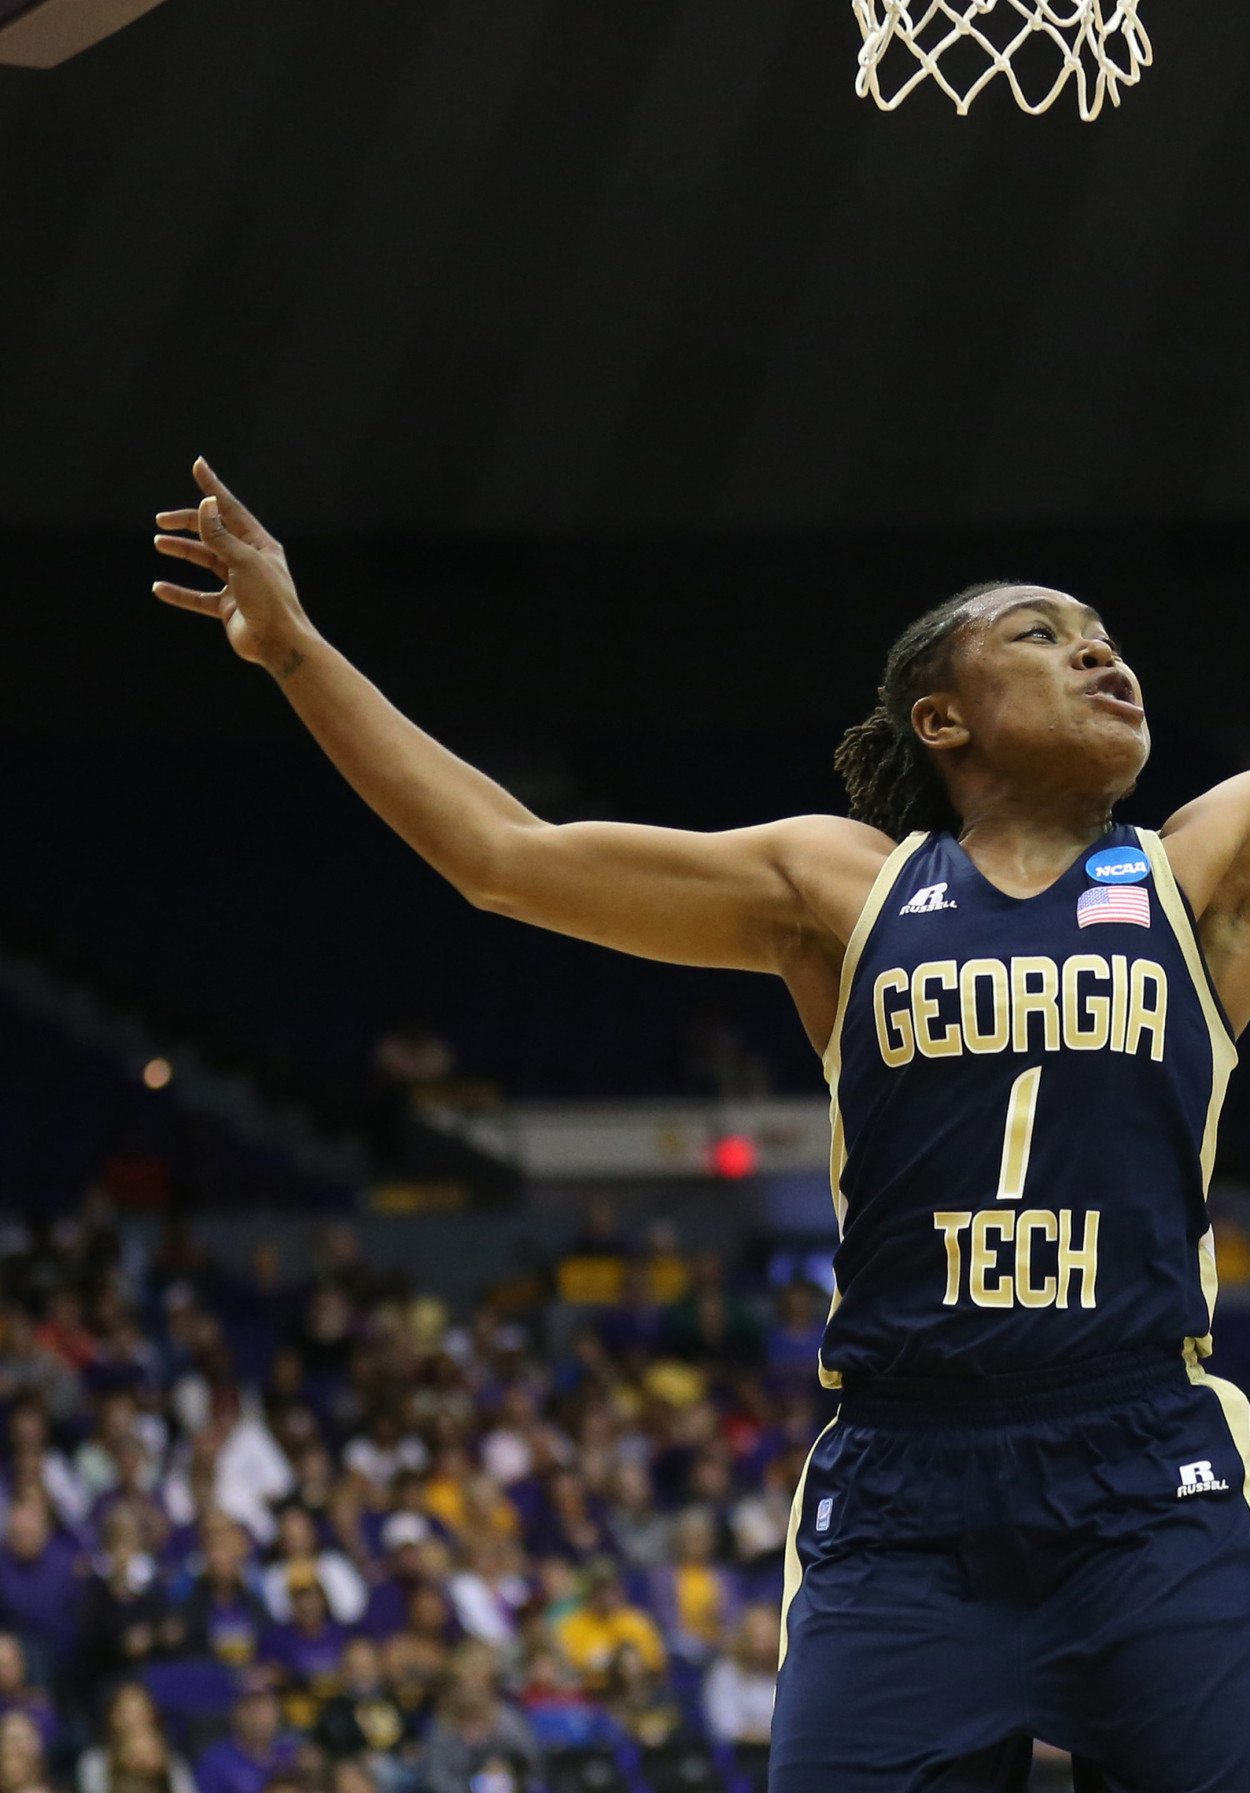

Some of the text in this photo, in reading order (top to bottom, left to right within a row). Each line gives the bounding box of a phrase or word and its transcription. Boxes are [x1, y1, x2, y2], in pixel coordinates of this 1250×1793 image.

[1094, 861, 1148, 878] NCAA
[899, 899, 958, 916] RUSSELL
[873, 954, 1168, 1068] GEORGIA
[996, 1065, 1043, 1201] 1
[933, 1208, 1100, 1309] TECH
[1176, 1479, 1230, 1498] RUSSELL
